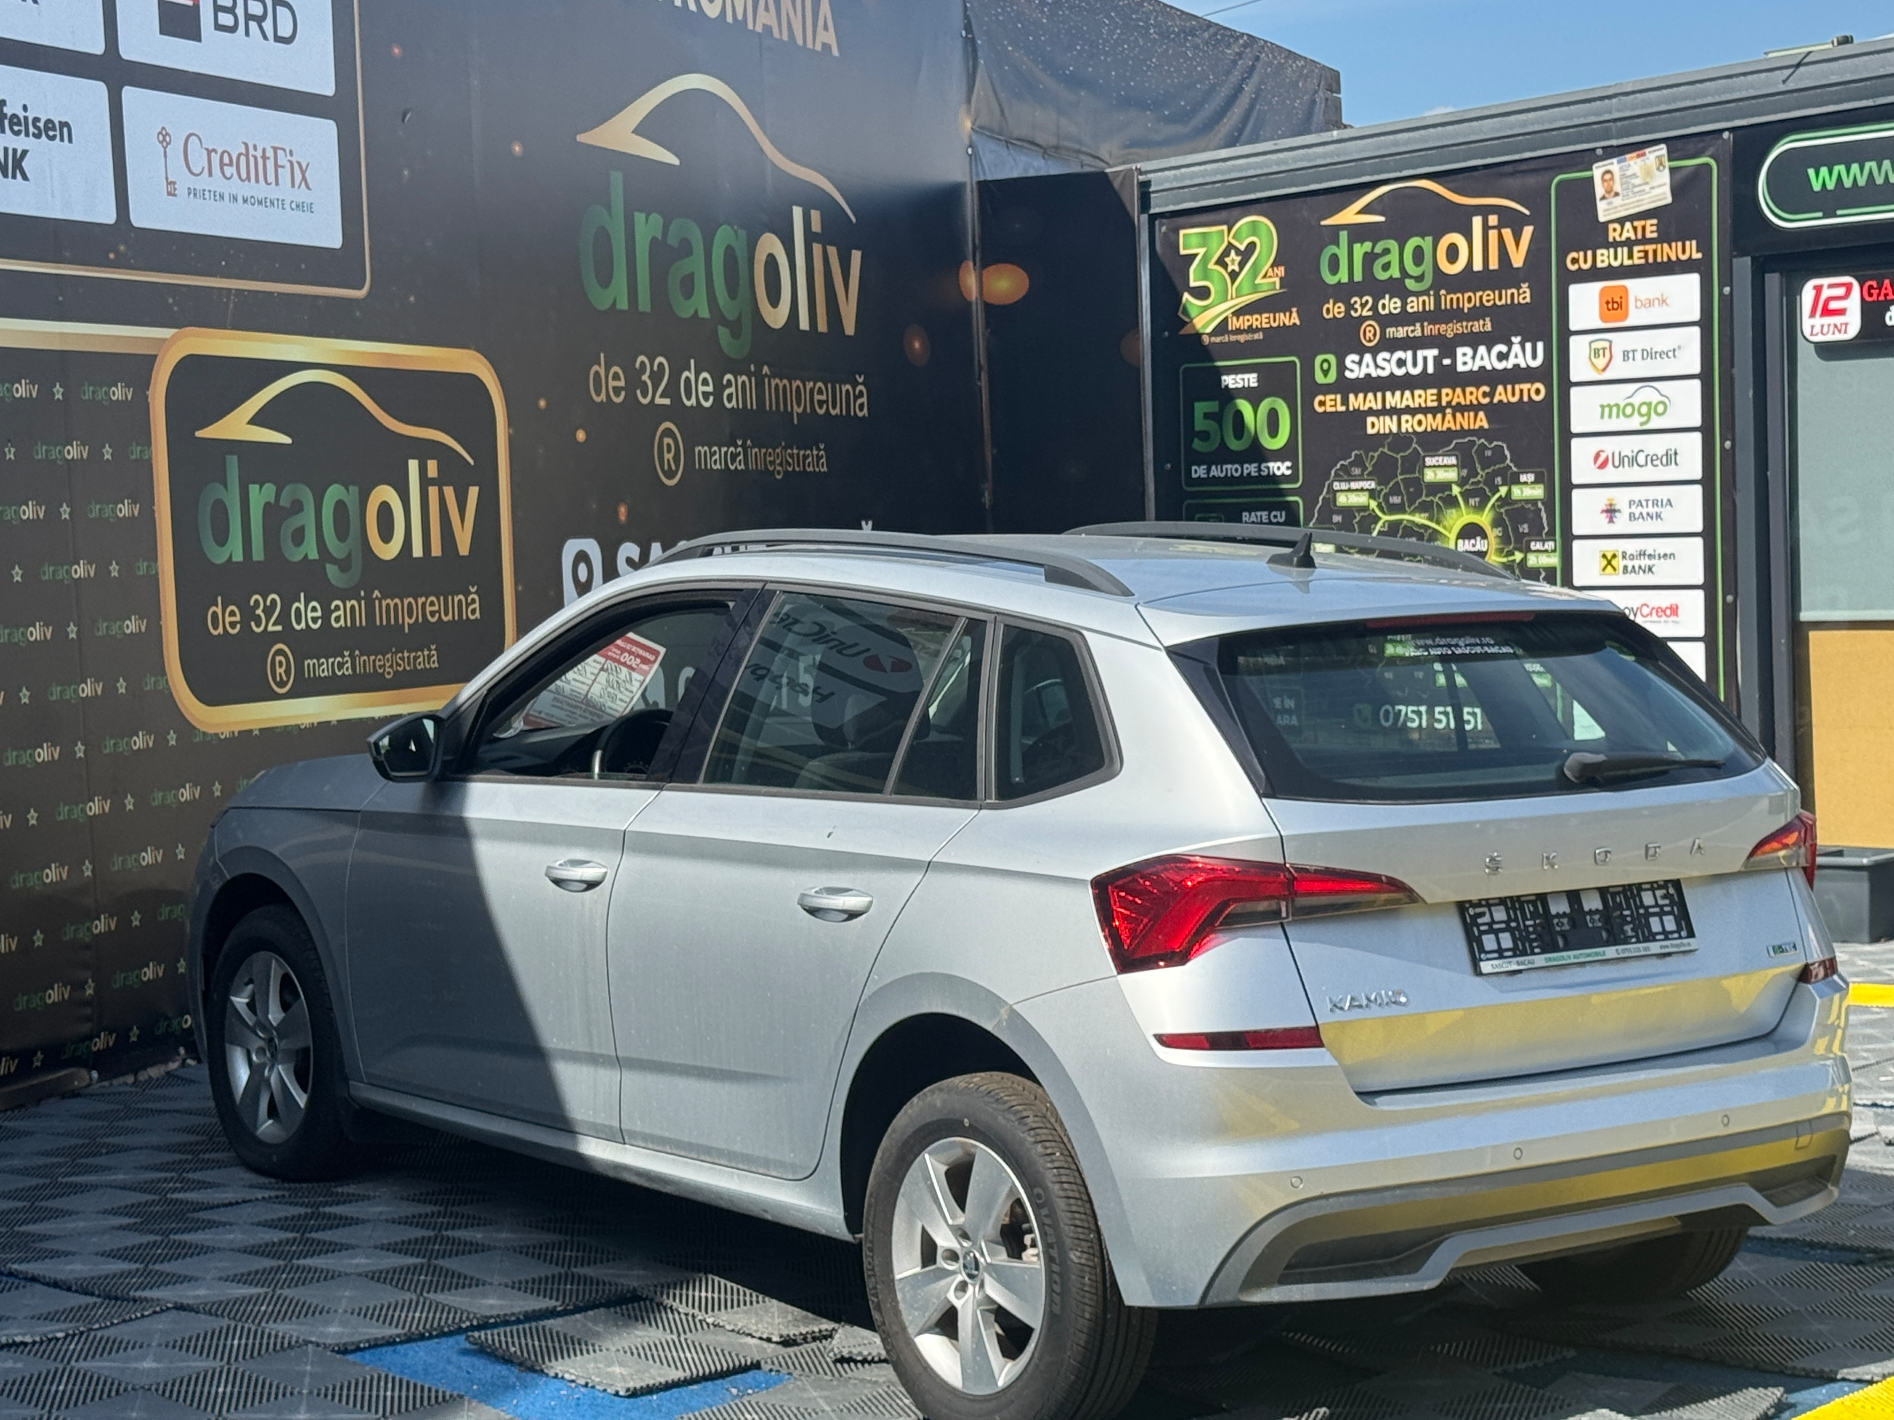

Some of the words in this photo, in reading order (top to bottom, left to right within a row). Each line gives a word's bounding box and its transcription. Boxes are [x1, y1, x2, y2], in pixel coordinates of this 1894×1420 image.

[213, 0, 298, 45] BRD
[182, 132, 312, 191] CreditFix
[187, 186, 225, 202] PRIETEN
[228, 192, 238, 204] IN
[242, 195, 286, 211] MOMENTE
[289, 200, 315, 214] CHEIE
[1608, 218, 1658, 242] RATE
[578, 170, 862, 360] dragoliv
[1319, 214, 1534, 292] dragoliv
[1565, 250, 1593, 272] CU
[1595, 240, 1702, 269] BULETINUL
[1177, 214, 1278, 322] 32
[1266, 265, 1285, 278] ANI
[1322, 298, 1346, 319] de
[1350, 295, 1374, 317] 32
[1377, 293, 1402, 315] de
[1406, 289, 1435, 314] ani
[1439, 282, 1531, 314] împreună
[1604, 295, 1624, 312] tbi
[1634, 294, 1669, 310] bank
[1808, 281, 1853, 319] 12
[1227, 307, 1300, 331] ÎMPREUNĂ
[1385, 321, 1422, 339] marcă
[1424, 316, 1493, 339] înregistrată
[1809, 322, 1849, 337] LUNI
[1344, 348, 1440, 379] SASCUT
[1456, 335, 1545, 374] BACĂU
[1593, 346, 1609, 360] BT
[1622, 349, 1638, 362] BT
[80, 382, 134, 405] dragoliv
[588, 352, 626, 404] de
[635, 355, 671, 406] 32
[680, 358, 714, 409] de
[722, 364, 757, 411] ani
[762, 364, 869, 425] împreună
[1221, 373, 1258, 389] PESTE
[1313, 394, 1346, 413] CEL
[1349, 390, 1383, 412] MAI
[1385, 388, 1438, 410] MARE
[1441, 385, 1491, 407] PARC
[1493, 382, 1546, 404] AUTO
[1191, 396, 1291, 453] 500
[1366, 414, 1398, 435] DIN
[1400, 408, 1489, 434] ROMÂNIA
[1599, 399, 1669, 427] mogo
[33, 440, 90, 465] dragoliv
[694, 439, 745, 471] marcă
[747, 439, 829, 480] înregistrată
[1611, 447, 1680, 469] UniCredit
[1191, 466, 1208, 479] DE
[1209, 464, 1242, 477] AUTO
[1243, 463, 1259, 476] PE
[1260, 461, 1293, 475] STOC
[87, 499, 140, 522] dragoliv
[1241, 511, 1269, 524] RATE
[1270, 510, 1286, 523] CU
[1628, 497, 1674, 510] PATRIA
[1628, 511, 1664, 523] BANK
[198, 454, 480, 589] dragoliv
[1456, 536, 1488, 552] BACĂU
[1621, 549, 1676, 562] Raiffeisen
[40, 560, 96, 584] dragoliv
[1621, 563, 1656, 576] BANK
[207, 595, 241, 636] de
[249, 593, 283, 633] 32
[290, 591, 322, 631] de
[330, 590, 366, 629] ani
[374, 585, 481, 633] împreună
[95, 615, 147, 638] dragoliv
[303, 650, 352, 679] marcă
[354, 644, 440, 679] înregistrată
[48, 678, 103, 703] dragoliv
[1380, 704, 1427, 729] 0751
[1433, 705, 1455, 730] 51
[1463, 706, 1482, 731] 51
[3, 743, 60, 768] dragoliv
[103, 731, 155, 756] dragoliv
[55, 796, 111, 822] dragoliv
[151, 783, 201, 806] dragoliv
[10, 863, 69, 890] dragoliv
[110, 846, 164, 872] dragoliv
[61, 915, 118, 942] dragoliv
